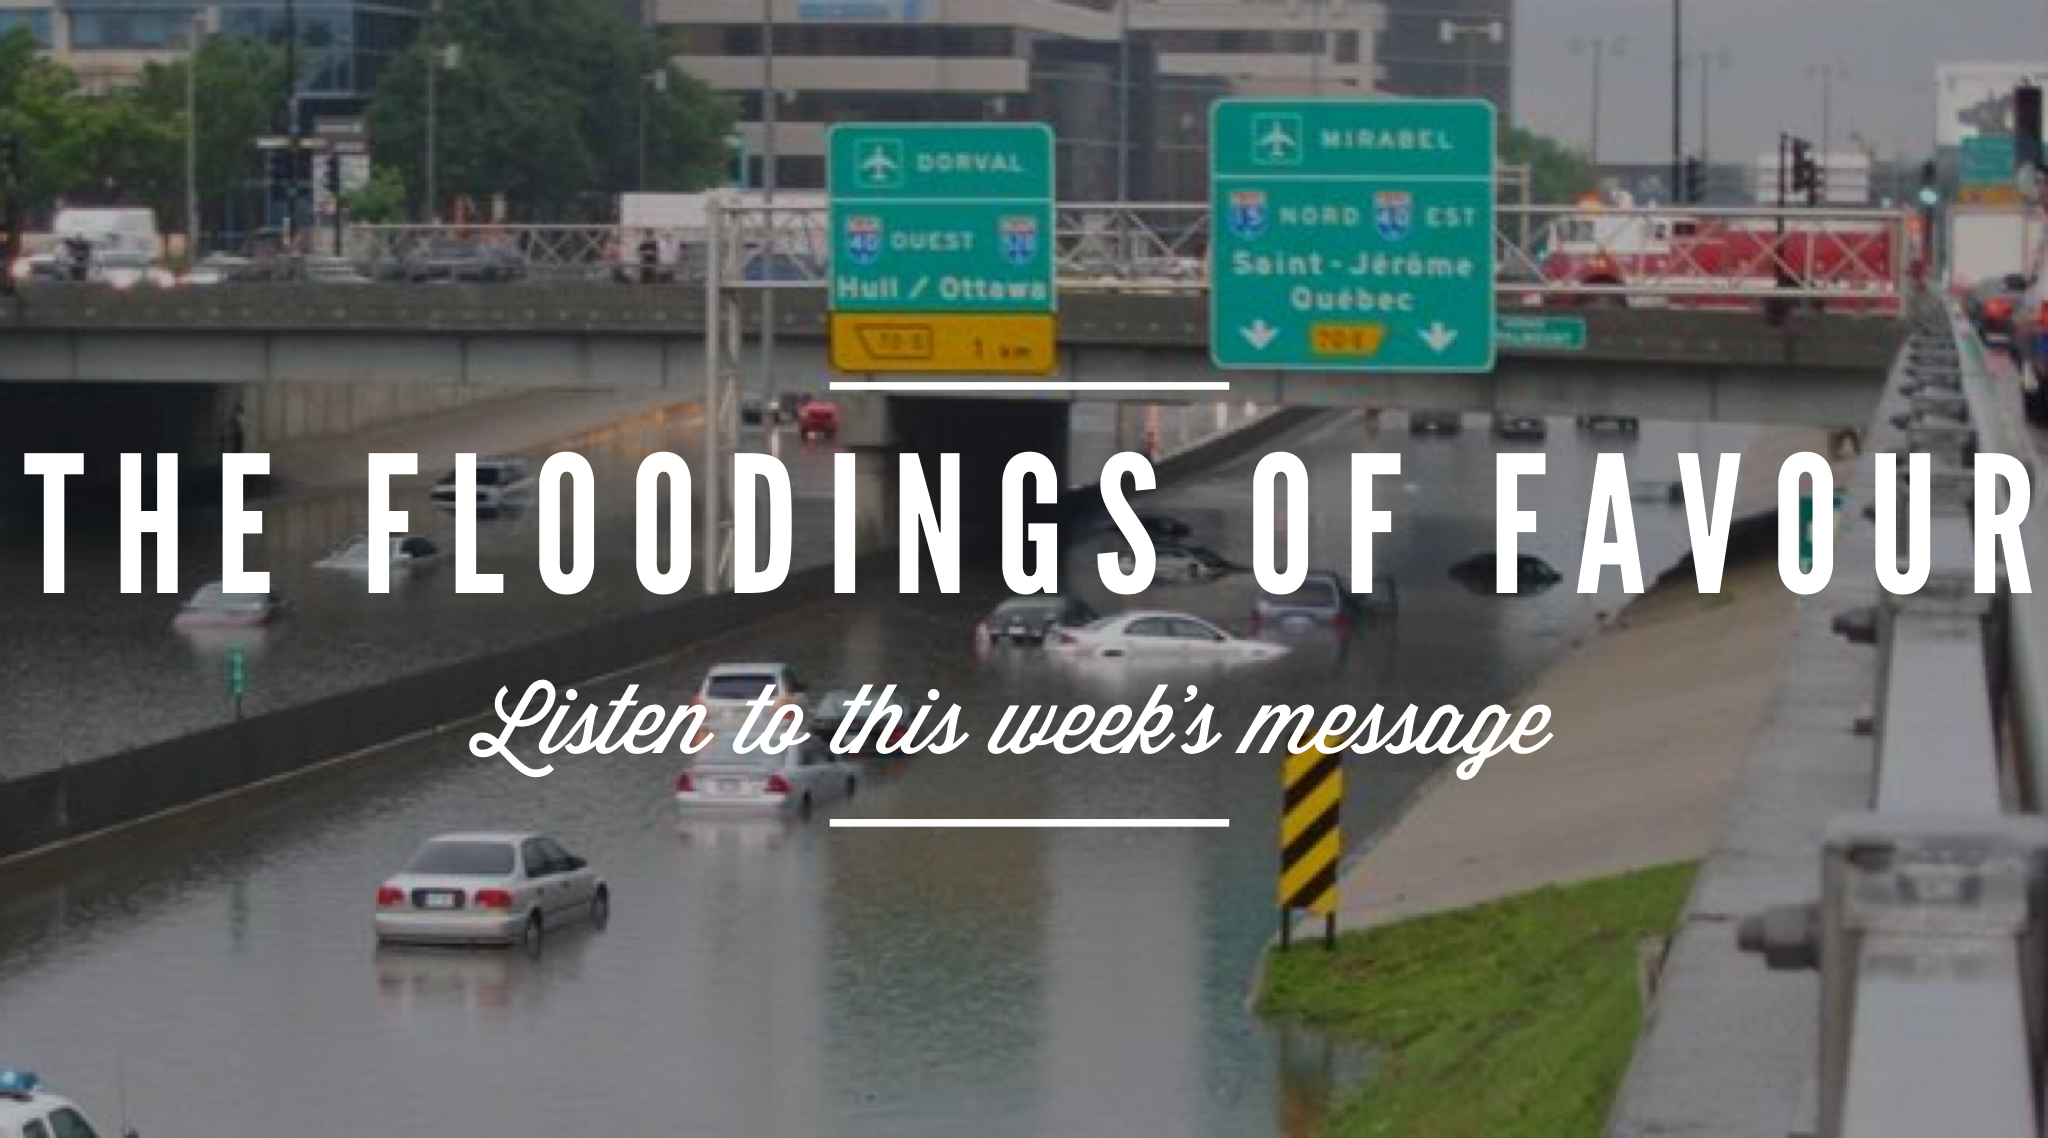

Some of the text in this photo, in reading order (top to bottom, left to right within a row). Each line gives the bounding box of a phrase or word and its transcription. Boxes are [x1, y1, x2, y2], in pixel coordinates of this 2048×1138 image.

[1319, 128, 1454, 150] MIRABEL
[916, 153, 1024, 172] DORVAL
[1279, 207, 1360, 227] NORD
[1378, 206, 1410, 227] 40
[1425, 207, 1476, 227] EST
[890, 231, 975, 250] OUEST
[837, 276, 898, 298] Hull
[939, 276, 1047, 299] Ottawa
[1290, 286, 1414, 312] Québec
